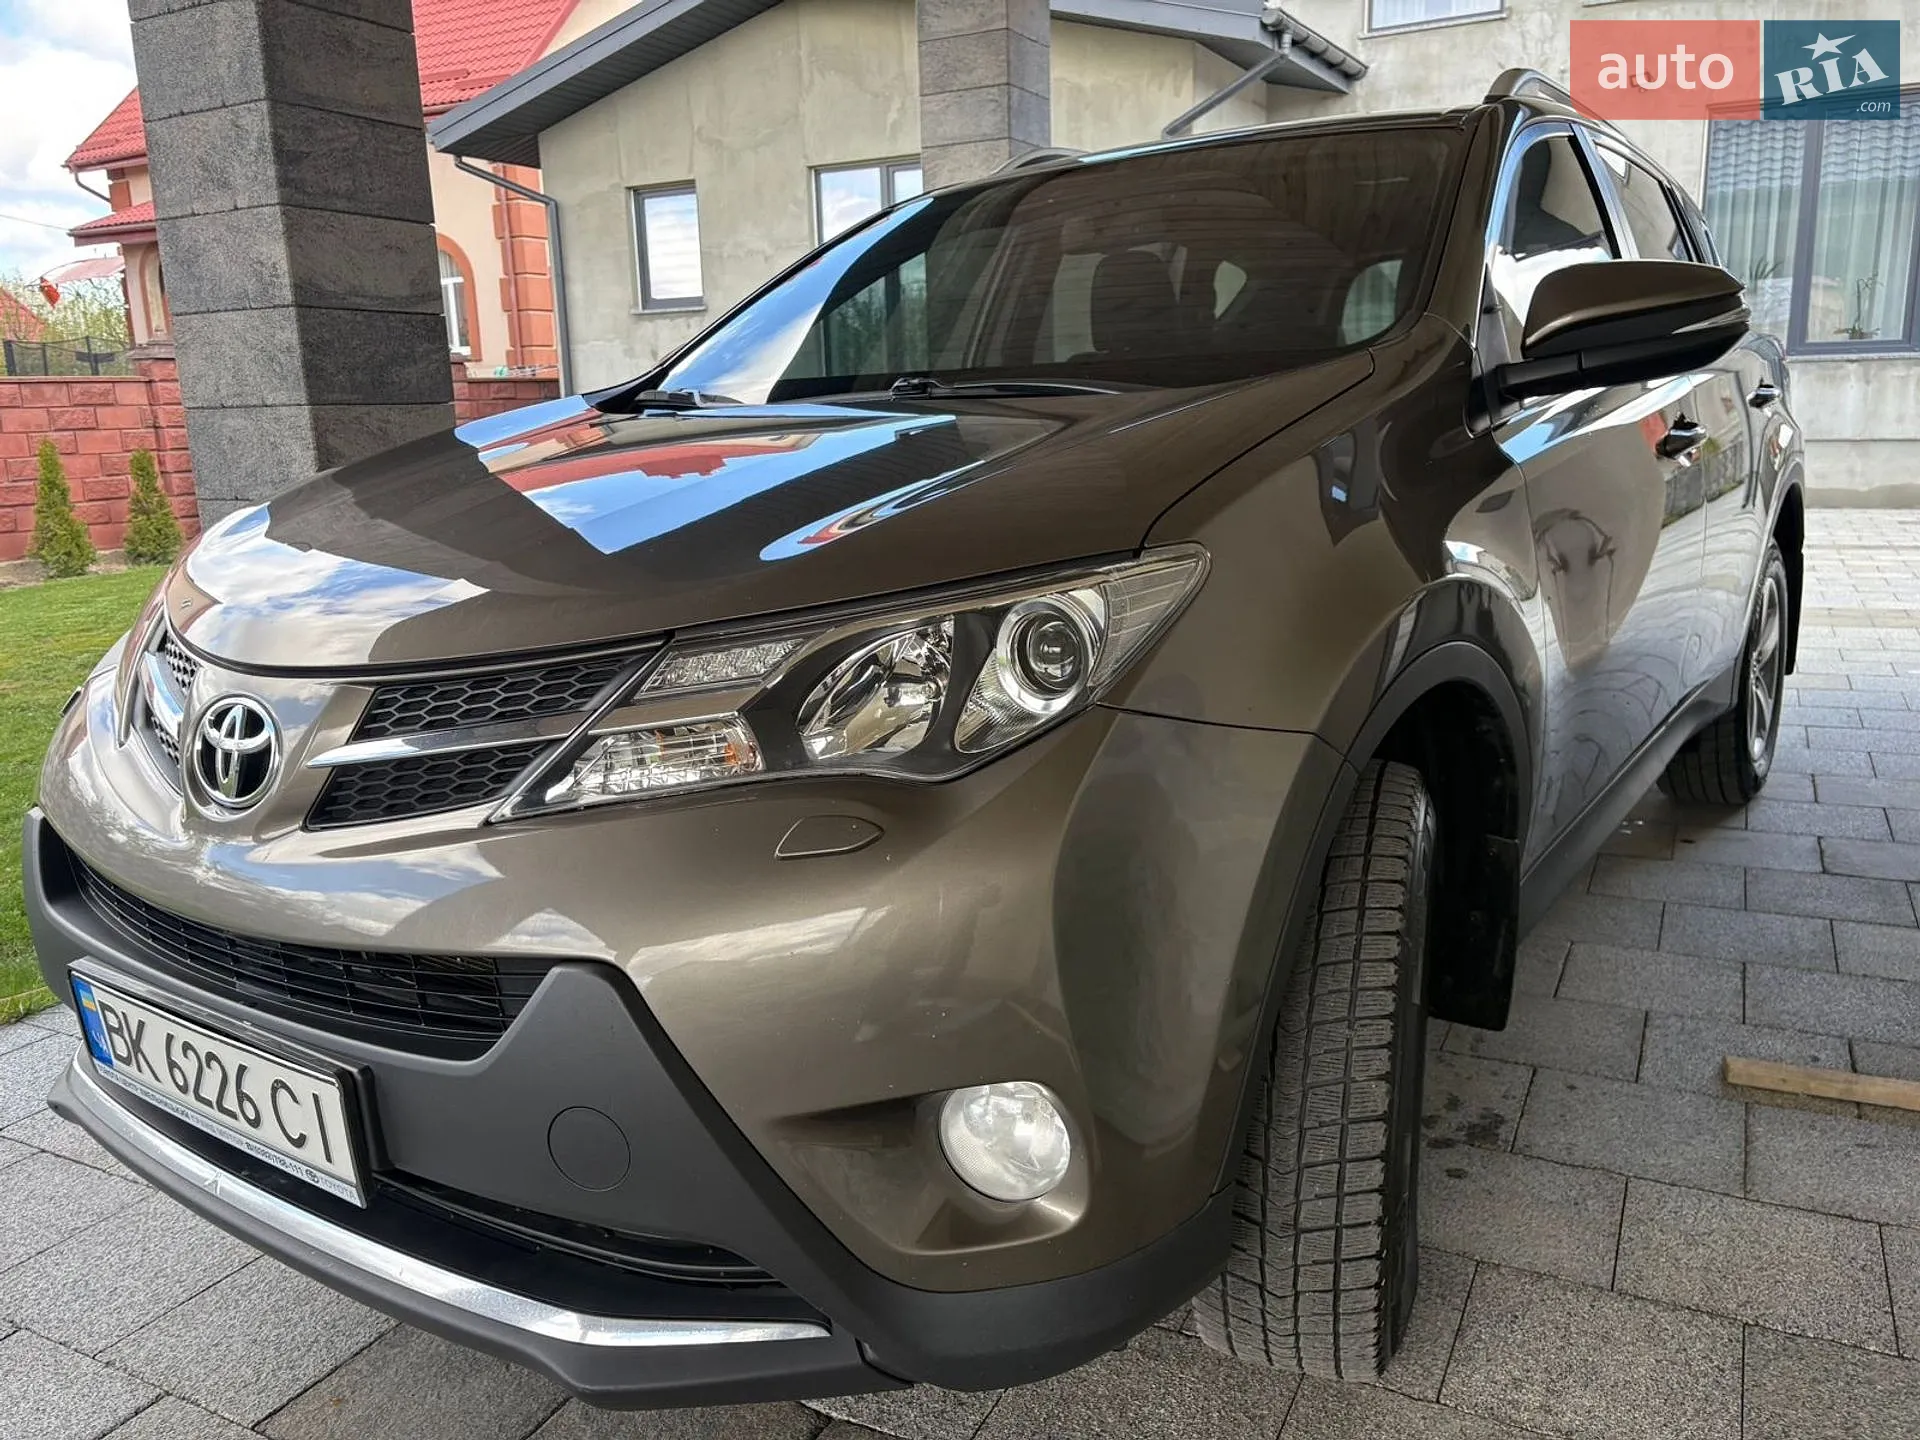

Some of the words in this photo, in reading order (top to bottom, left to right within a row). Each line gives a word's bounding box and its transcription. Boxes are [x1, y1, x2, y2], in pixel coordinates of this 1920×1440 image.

[97, 998, 162, 1084] BK
[164, 1032, 264, 1129] 6226
[270, 1078, 333, 1164] CI
